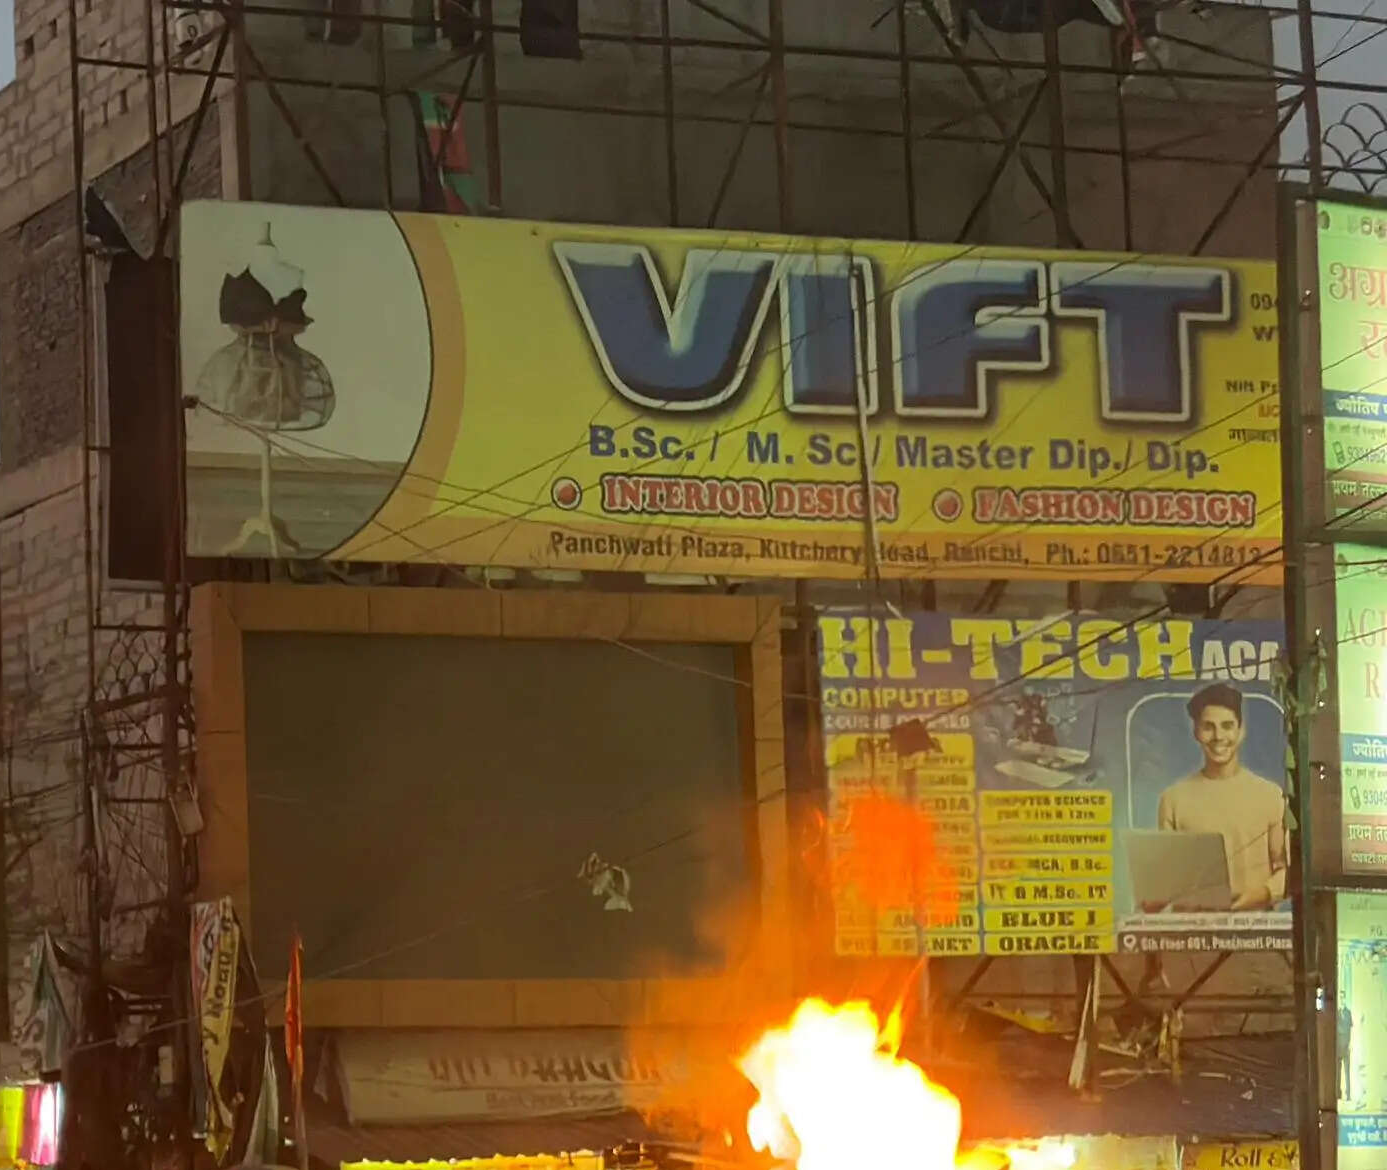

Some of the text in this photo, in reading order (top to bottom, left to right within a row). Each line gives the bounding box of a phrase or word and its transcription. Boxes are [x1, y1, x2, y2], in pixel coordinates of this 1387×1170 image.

[553, 241, 1231, 420] VIFT
[589, 425, 695, 461] B.Sc.
[895, 436, 1035, 471] Master
[1147, 441, 1220, 479] Dip.
[603, 475, 1256, 528] INTERIOR DESIGN FASHION DESIGN
[551, 529, 672, 557] Panchwati
[681, 535, 751, 562] Plaza,
[872, 543, 938, 566] oad,
[818, 617, 1194, 682] HI-TECH
[823, 686, 971, 709] COMPUTER
[1000, 911, 1075, 929] BLUE
[998, 934, 1101, 952] ORACLE
